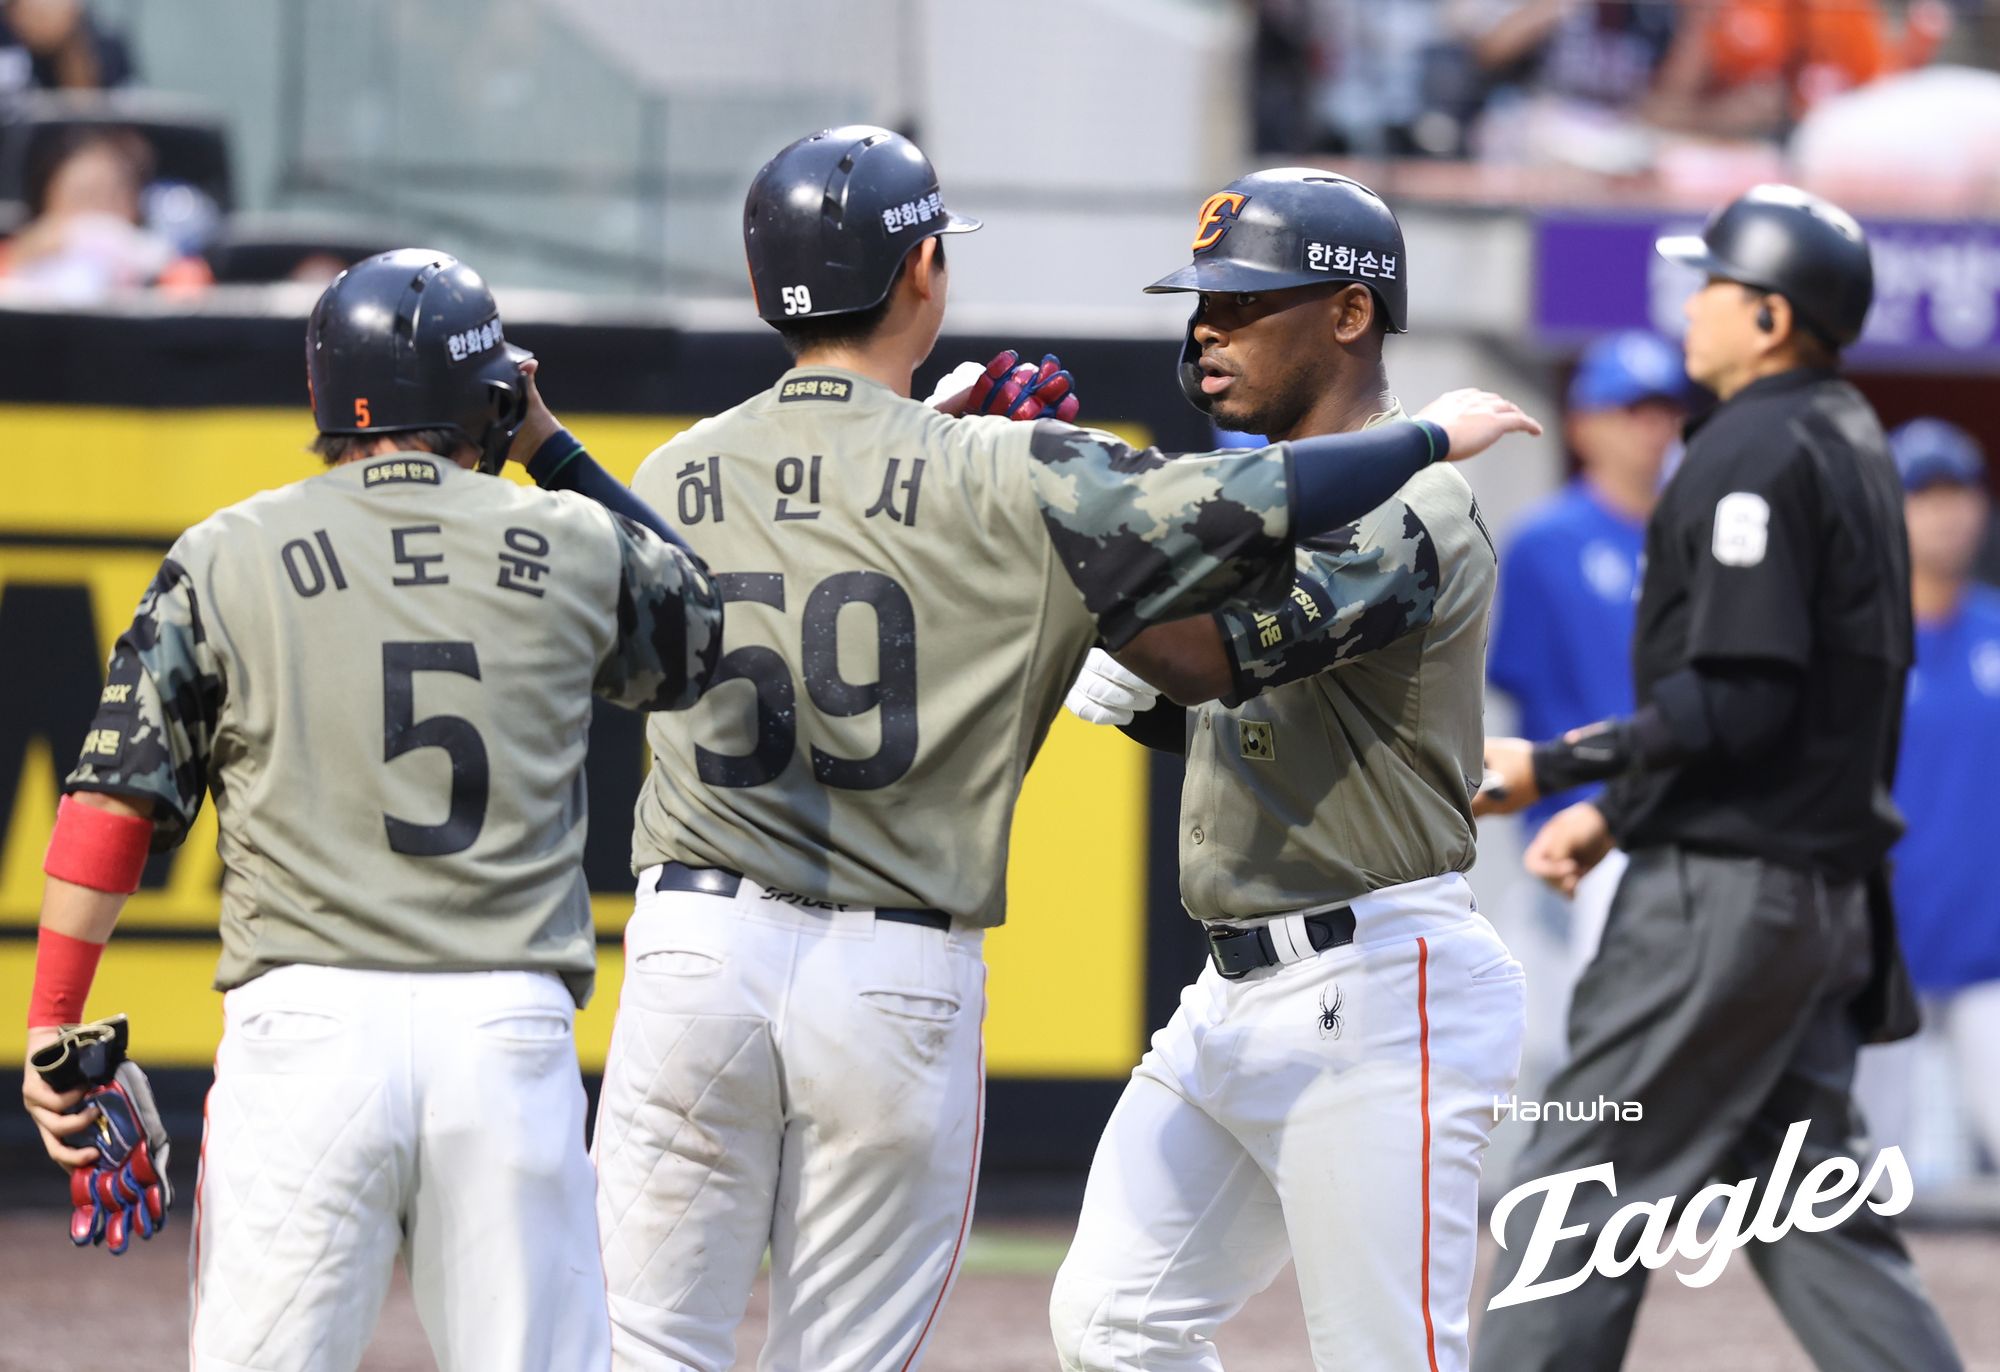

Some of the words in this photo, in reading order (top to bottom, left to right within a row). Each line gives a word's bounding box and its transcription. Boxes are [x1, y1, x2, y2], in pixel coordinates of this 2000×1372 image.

[1307, 242, 1396, 280] 한화손보
[782, 284, 812, 315] 59
[782, 381, 819, 397] 모두의
[820, 381, 848, 397] 안과
[354, 397, 371, 428] 5
[366, 463, 407, 483] 모두의
[1290, 580, 1321, 623] TSIX
[101, 684, 132, 704] SIX
[694, 571, 918, 791] 59
[382, 641, 489, 857] 5
